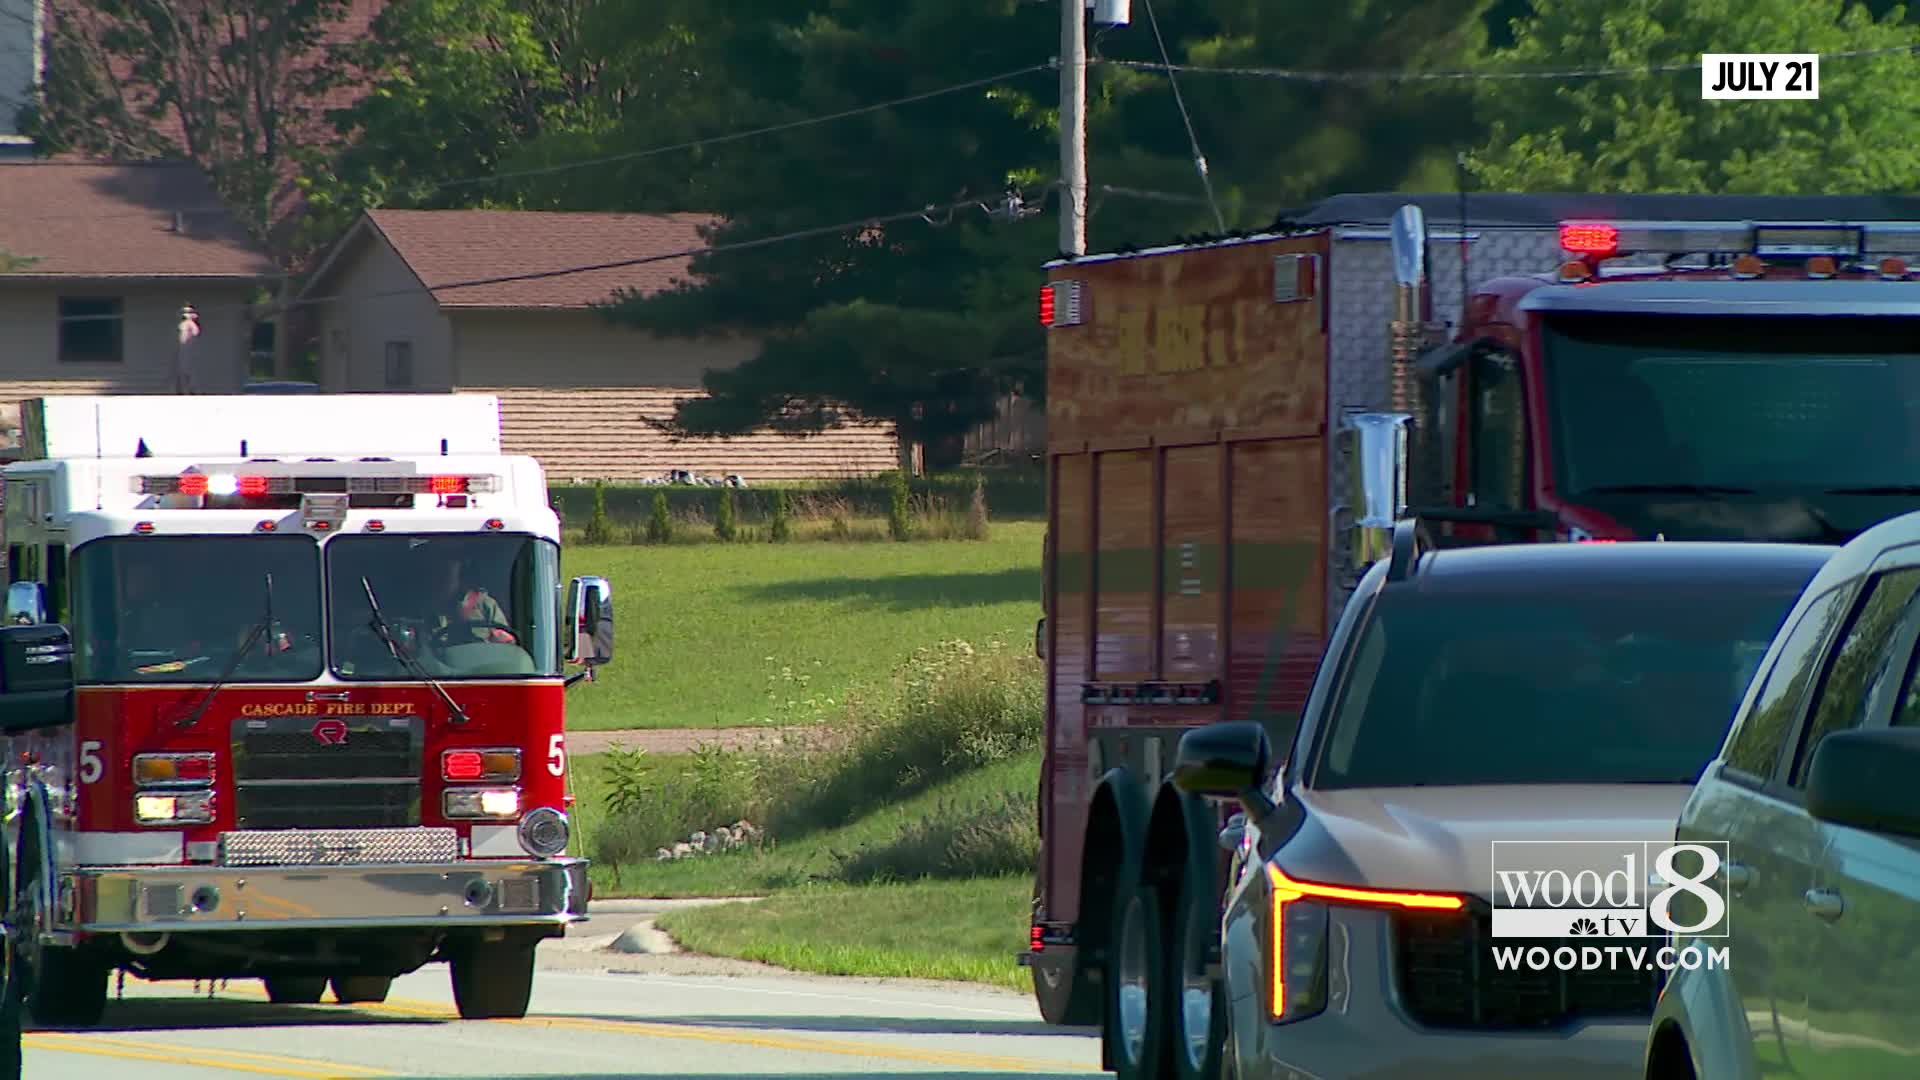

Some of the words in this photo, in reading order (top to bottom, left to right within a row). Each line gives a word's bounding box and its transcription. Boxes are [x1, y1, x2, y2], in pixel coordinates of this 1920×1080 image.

[241, 703, 318, 716] CASCADE
[326, 703, 365, 715] FIRE
[80, 740, 103, 784] 5
[546, 733, 565, 777] 5
